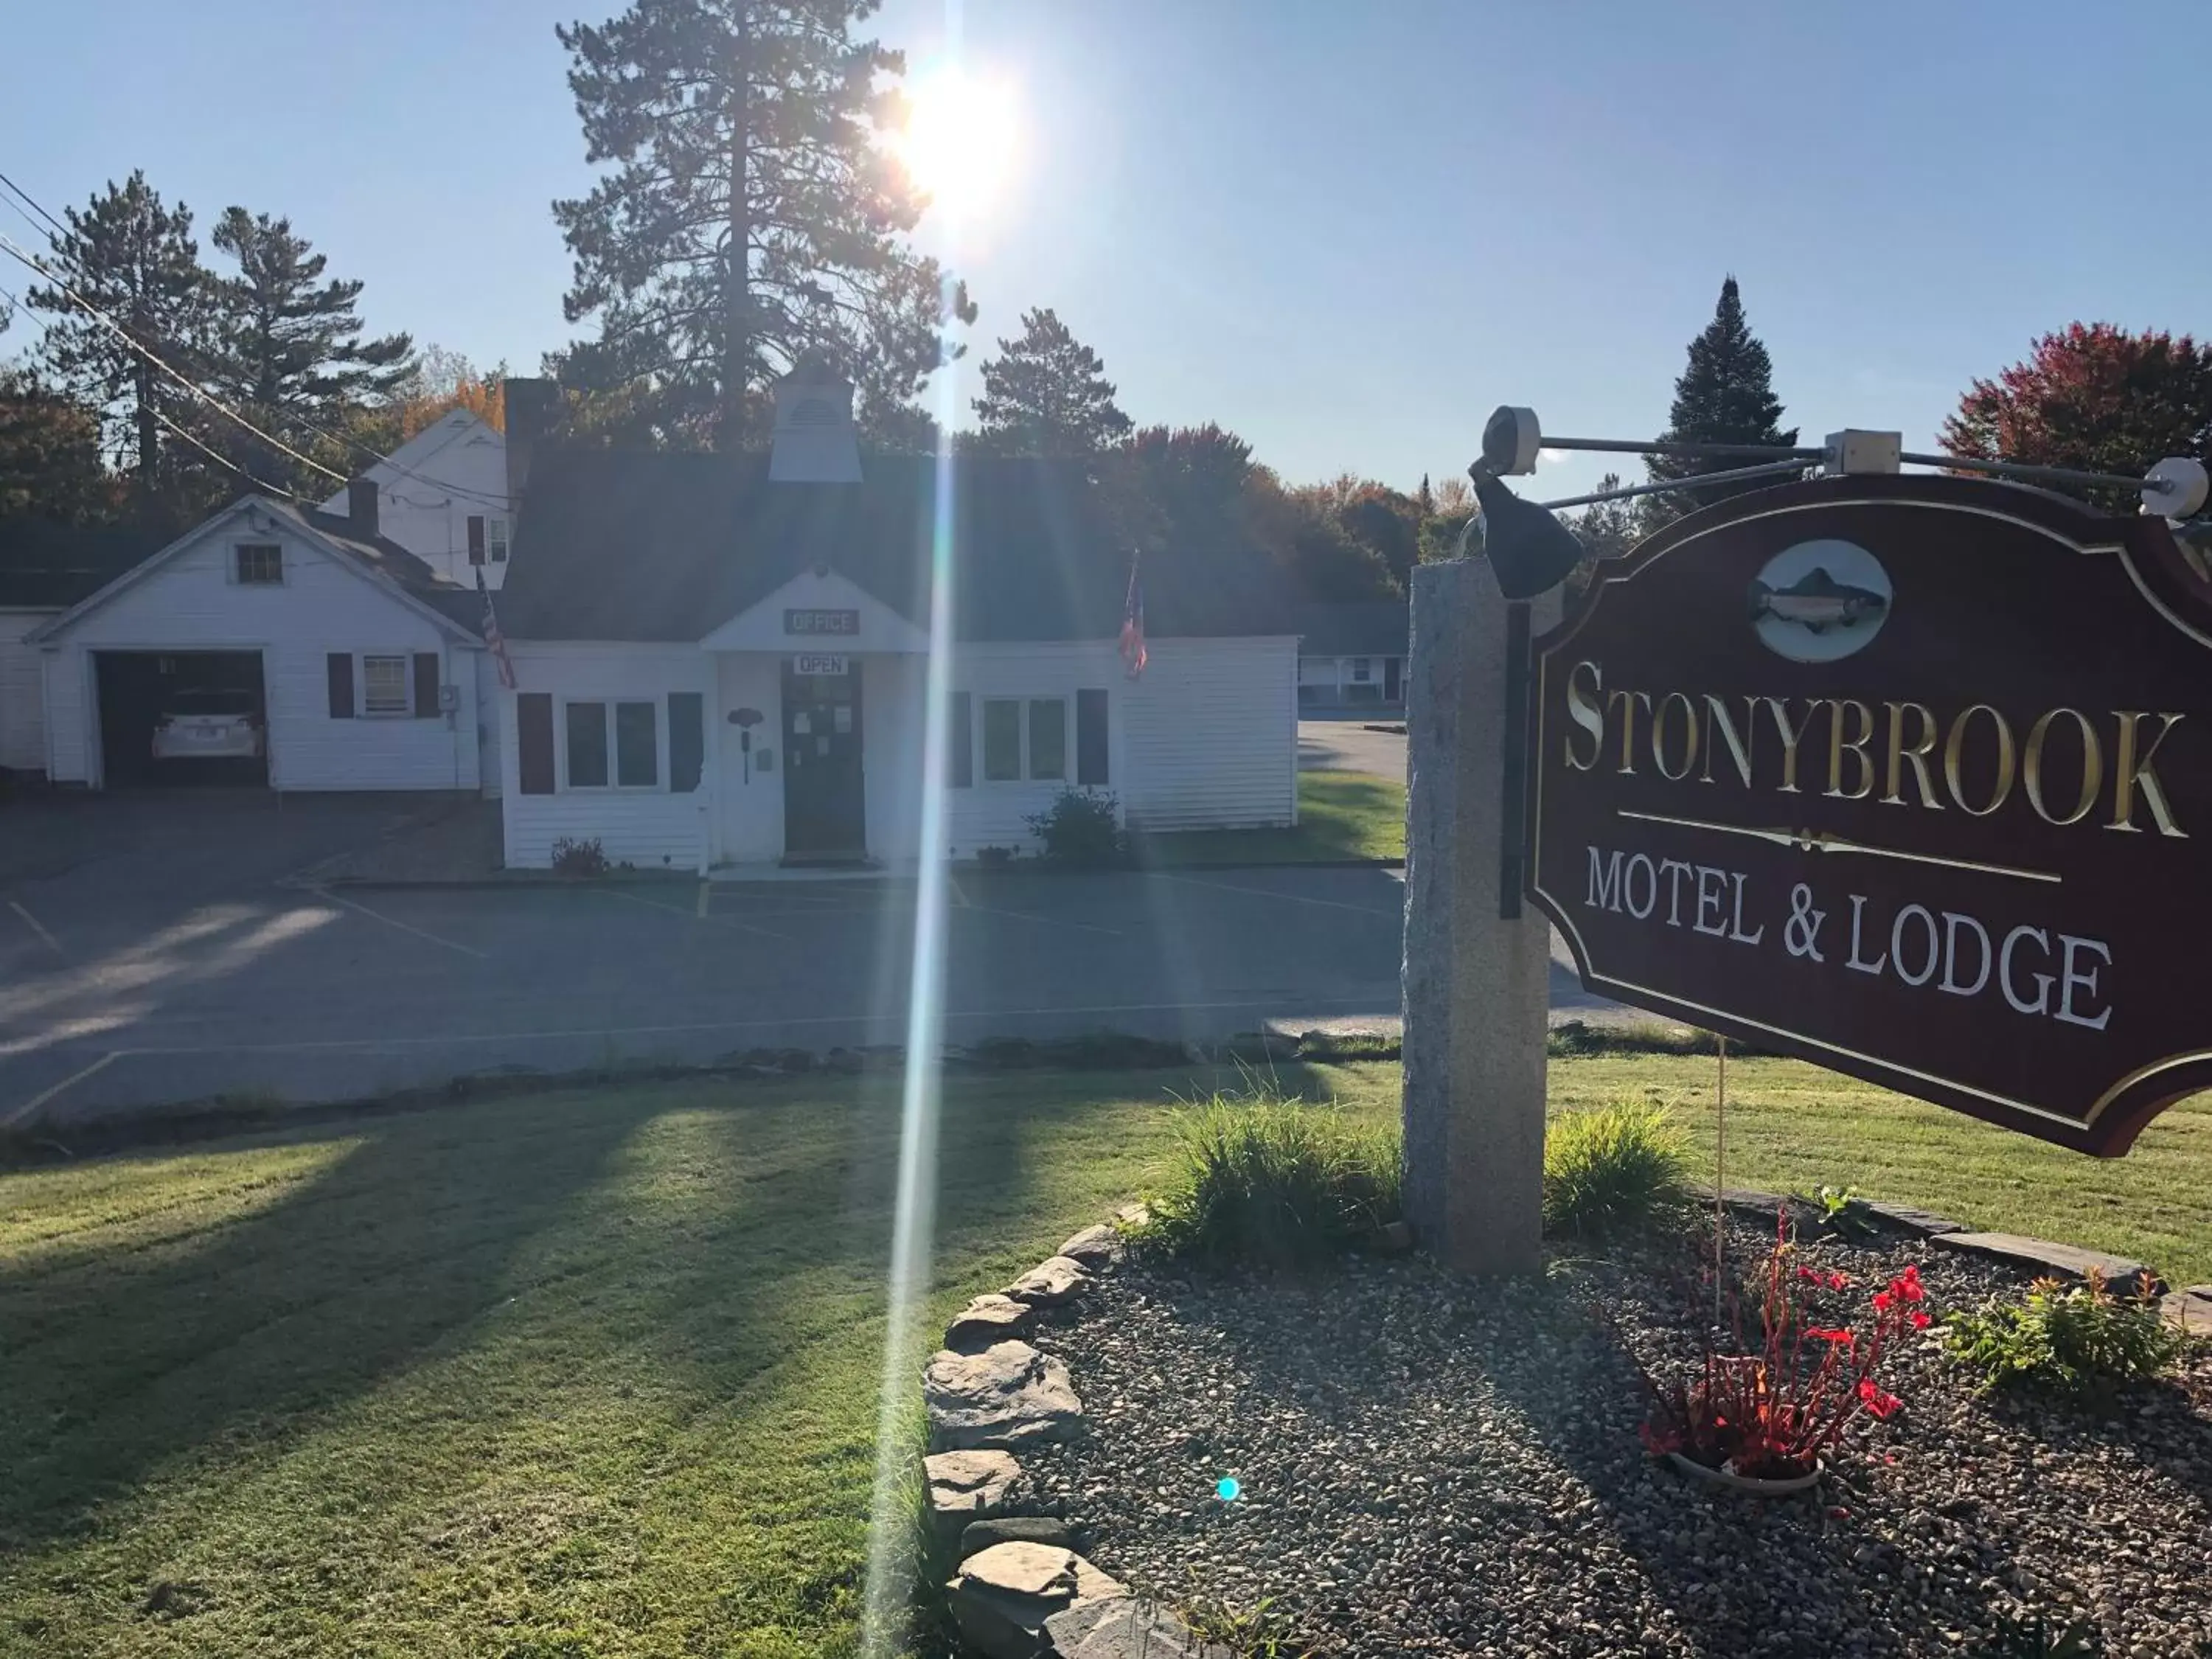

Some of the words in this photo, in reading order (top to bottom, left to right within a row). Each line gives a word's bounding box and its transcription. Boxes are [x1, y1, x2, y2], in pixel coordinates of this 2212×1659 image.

[793, 613, 852, 631] OFFICE
[800, 655, 841, 673] OPEN
[1565, 661, 2190, 838] STONYBROOK
[1585, 846, 1764, 945] MOTEL
[1784, 883, 1825, 963] &
[1845, 894, 2113, 1031] LODGE
